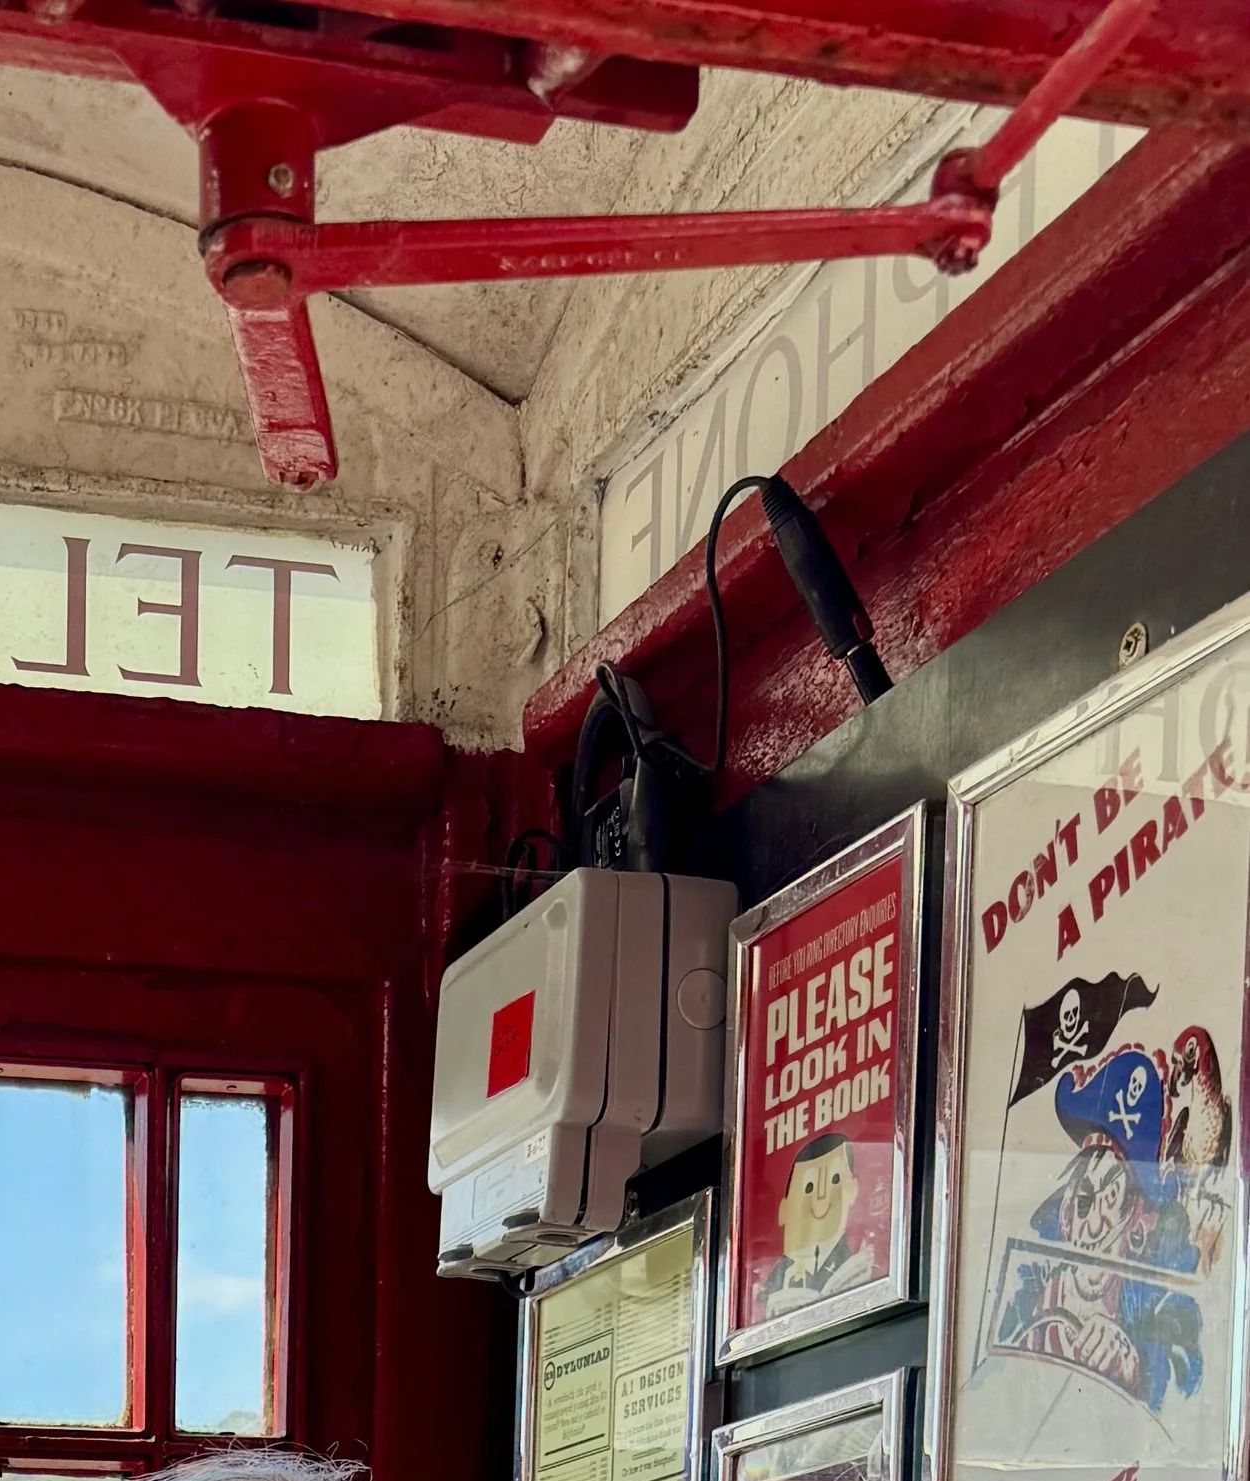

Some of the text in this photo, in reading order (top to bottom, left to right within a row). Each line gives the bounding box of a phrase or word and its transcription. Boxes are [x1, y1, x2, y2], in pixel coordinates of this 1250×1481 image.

[982, 747, 1144, 954] DON'T BE
[1057, 904, 1081, 961] A
[1088, 737, 1235, 923] PIRATE
[768, 891, 896, 991] BEFORE YOU RING DIRECTORY ENQUIRIES
[766, 934, 894, 1067] PLEASE
[765, 1010, 891, 1111] LOOK IN
[765, 1059, 890, 1155] THE BOOK
[556, 1346, 610, 1379] DYLUNIAD
[623, 1385, 682, 1419] SERVICES
[640, 1361, 685, 1391] DESIGN
